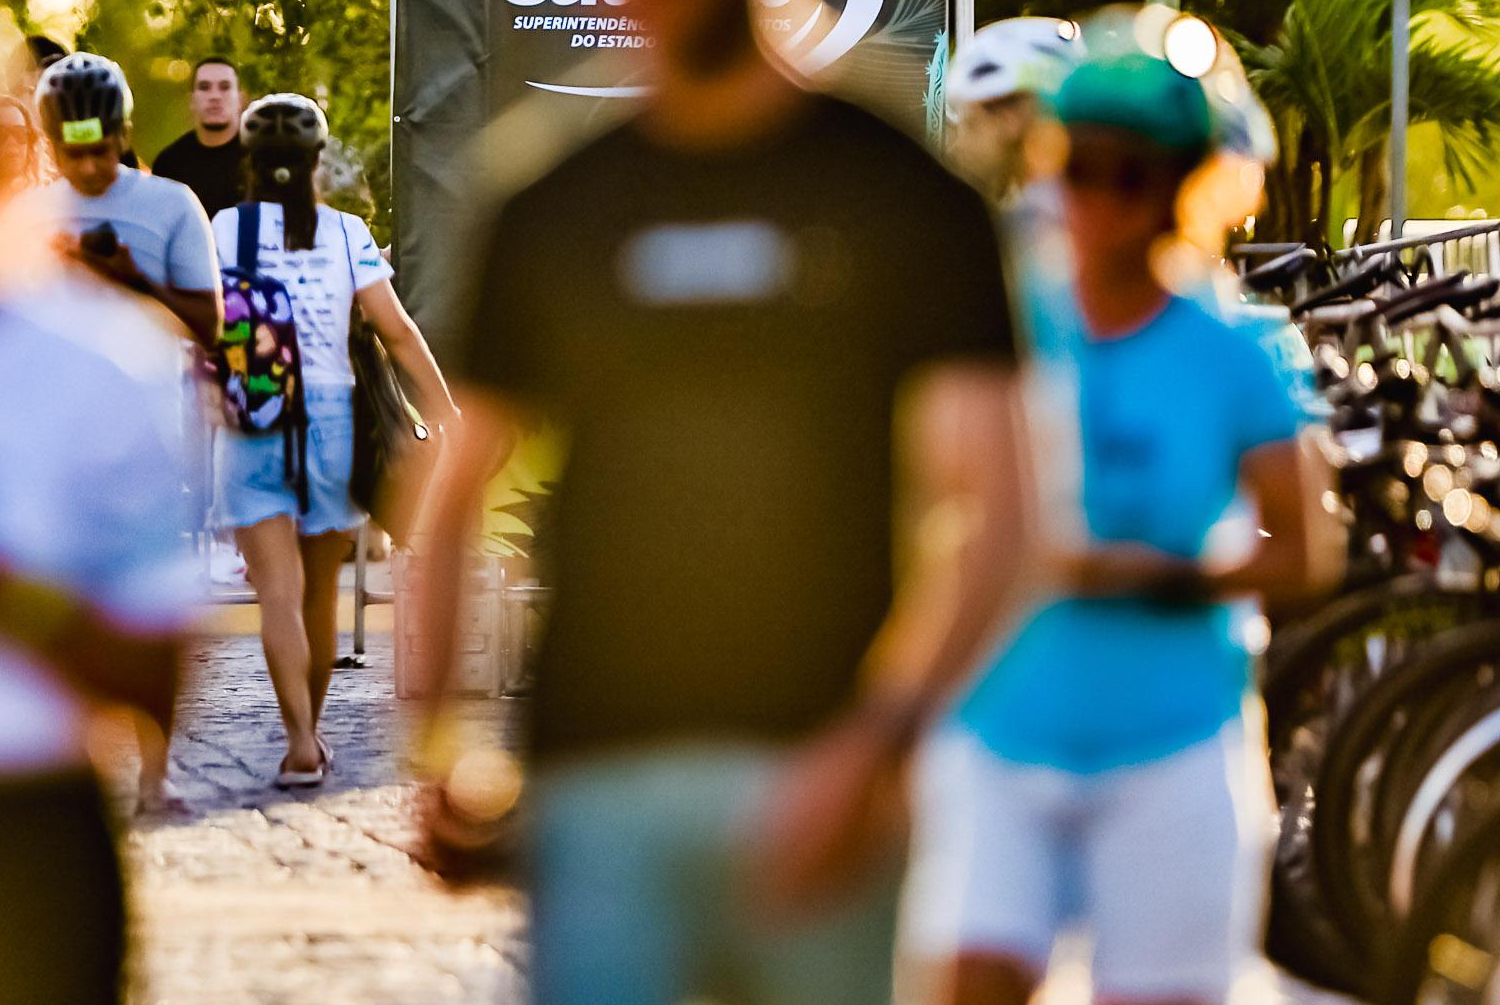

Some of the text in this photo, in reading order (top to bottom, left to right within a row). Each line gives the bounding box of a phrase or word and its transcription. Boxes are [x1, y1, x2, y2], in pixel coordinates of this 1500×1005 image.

[513, 14, 650, 32] SUPERINTENDÊNC
[570, 34, 657, 50] DO ESTADO
